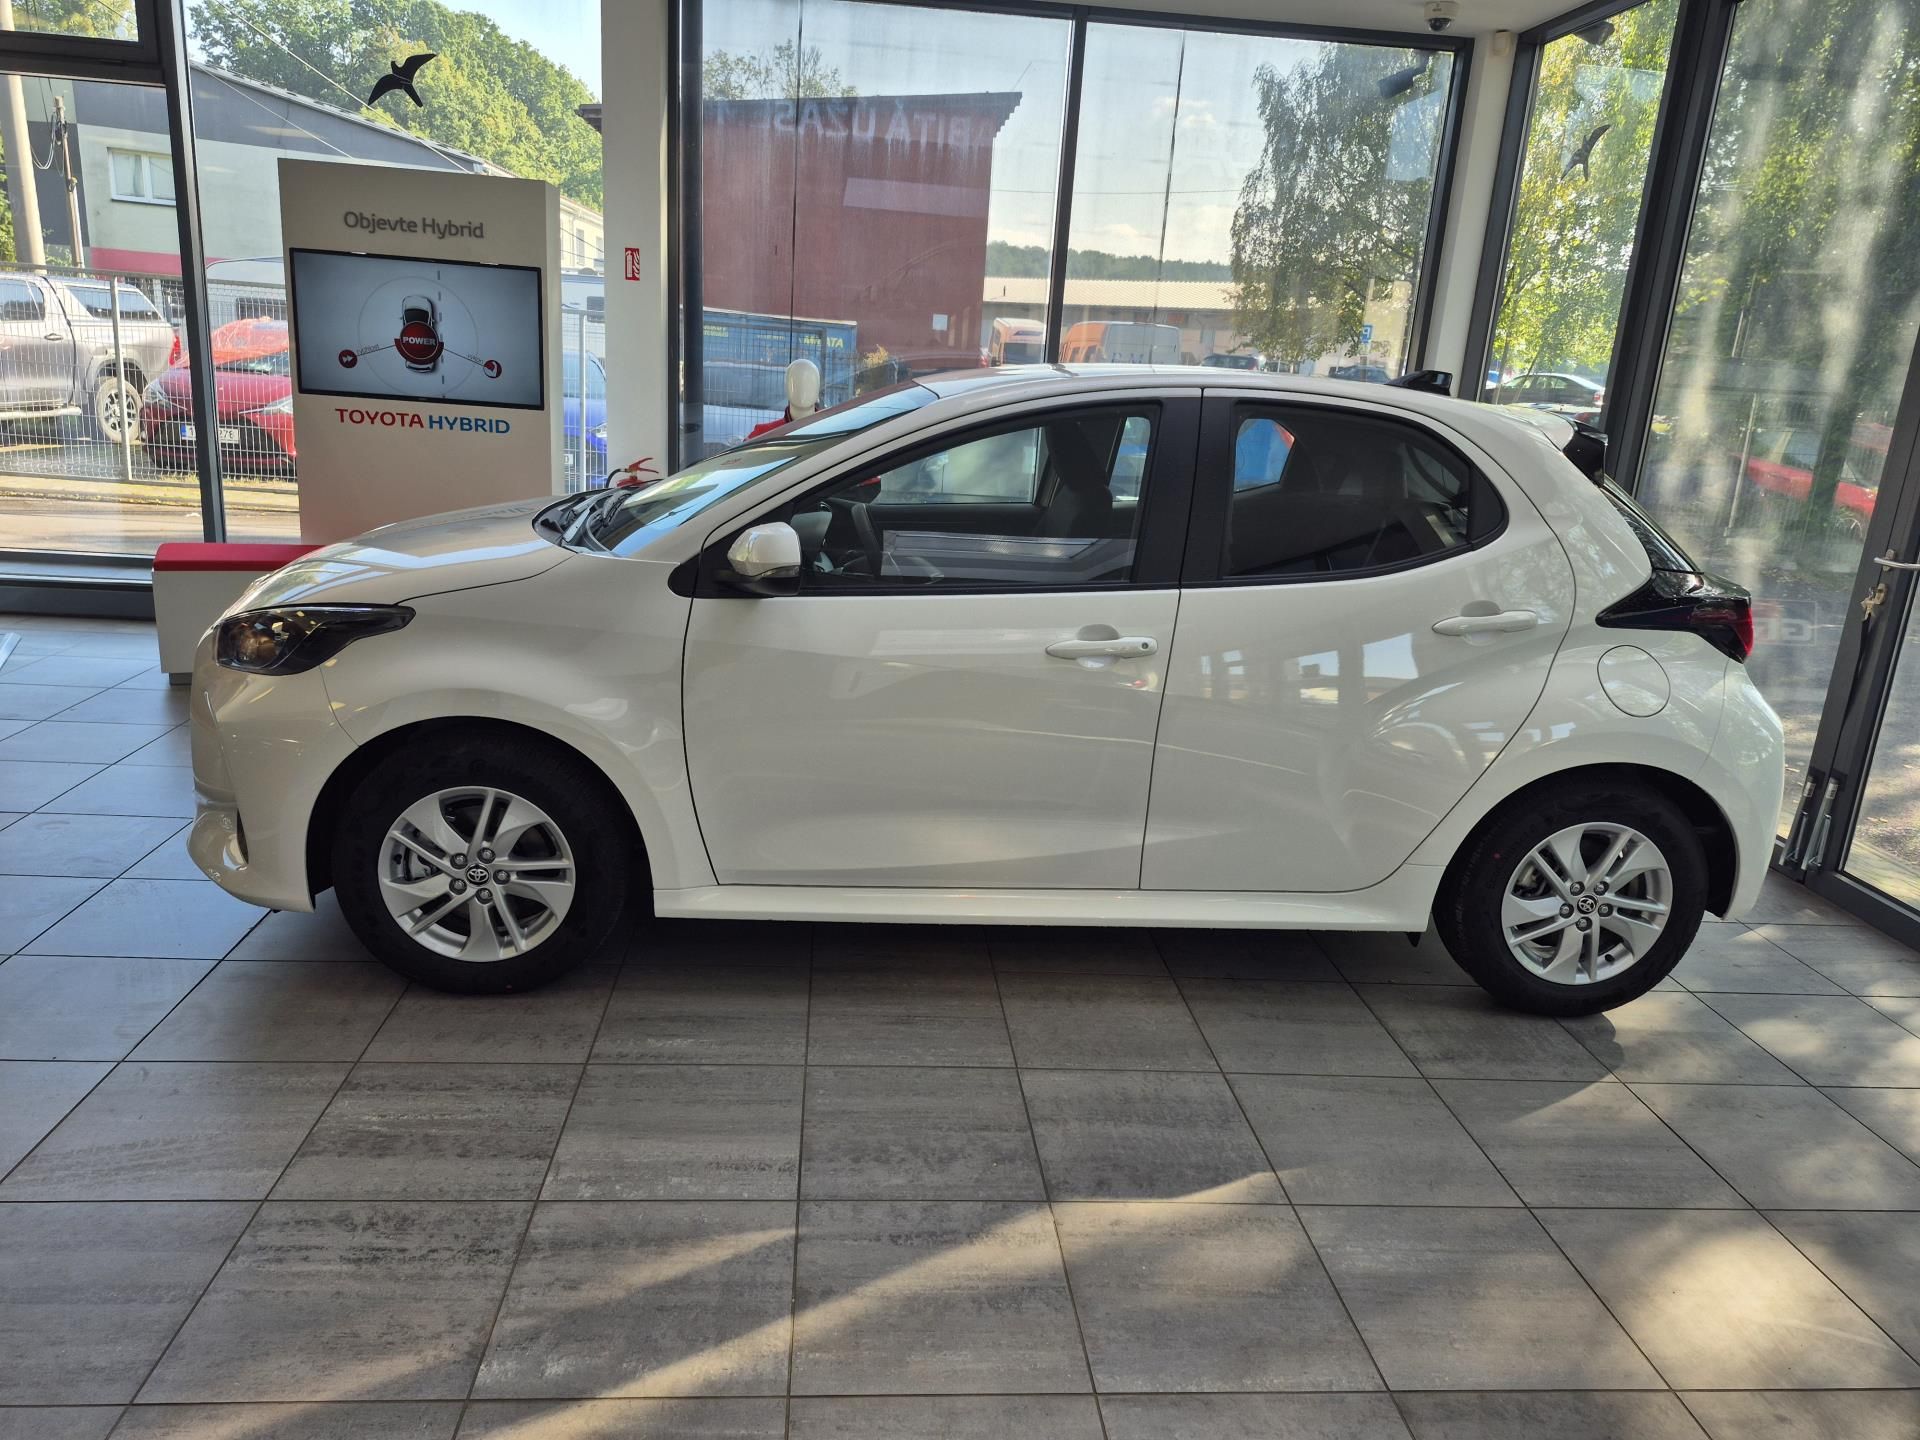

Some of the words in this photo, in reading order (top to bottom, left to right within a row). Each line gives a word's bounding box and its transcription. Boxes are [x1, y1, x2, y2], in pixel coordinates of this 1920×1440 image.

[343, 211, 418, 234] Objevte
[422, 217, 485, 239] Hybrid
[402, 336, 437, 346] POWER
[335, 408, 425, 429] TOYOTA
[428, 415, 511, 434] HYBRID
